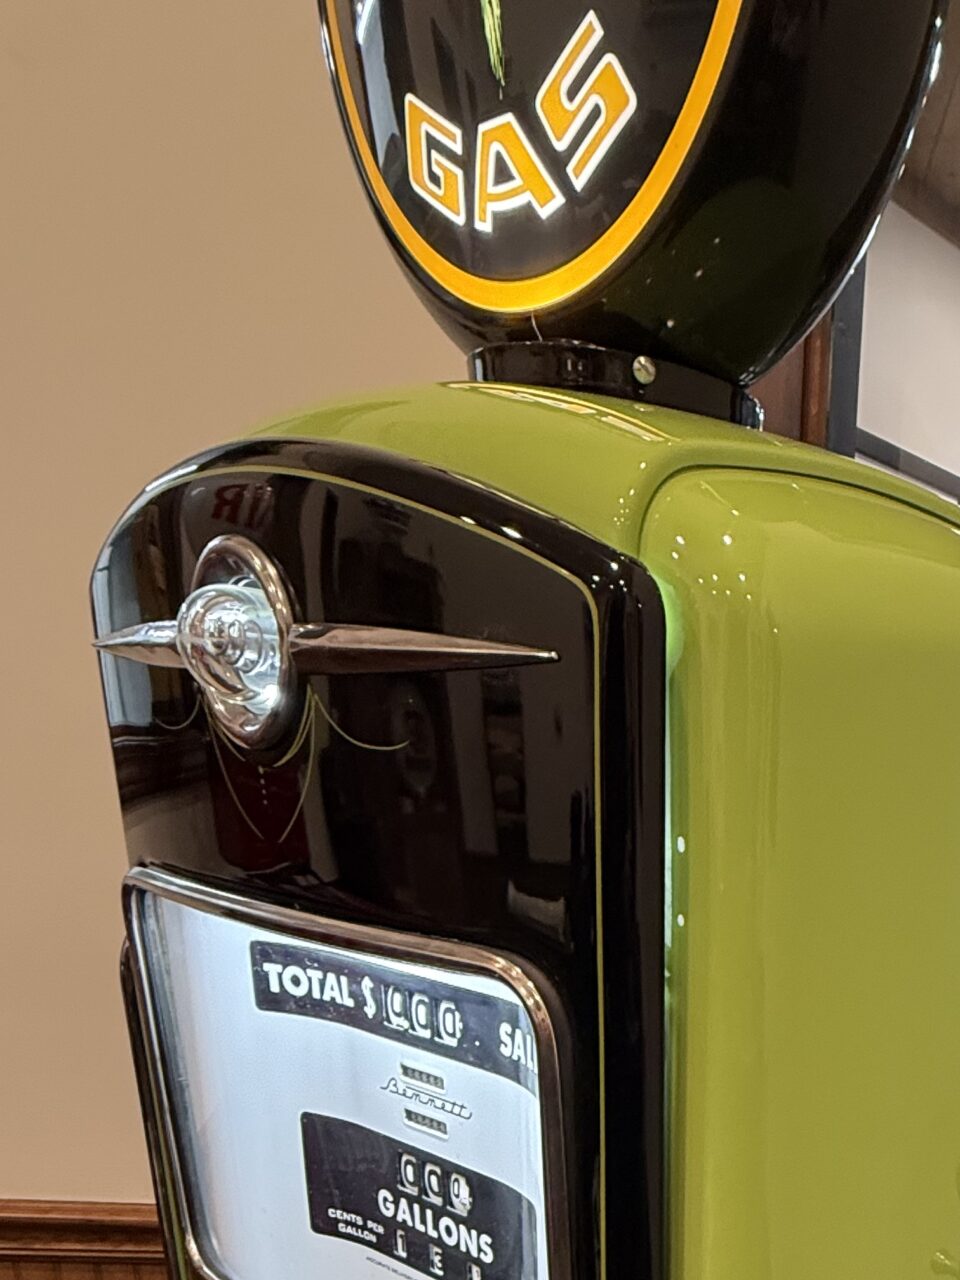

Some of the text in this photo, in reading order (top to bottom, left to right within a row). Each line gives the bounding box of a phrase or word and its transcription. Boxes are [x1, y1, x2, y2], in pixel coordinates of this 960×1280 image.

[404, 9, 638, 232] GAS
[262, 962, 354, 1008] TOTAL
[360, 976, 377, 1019] $
[379, 1077, 473, 1120] Bennett
[327, 1207, 385, 1235] CENTS PER
[337, 1222, 377, 1244] GALLON
[377, 1188, 494, 1264] GALLONS
